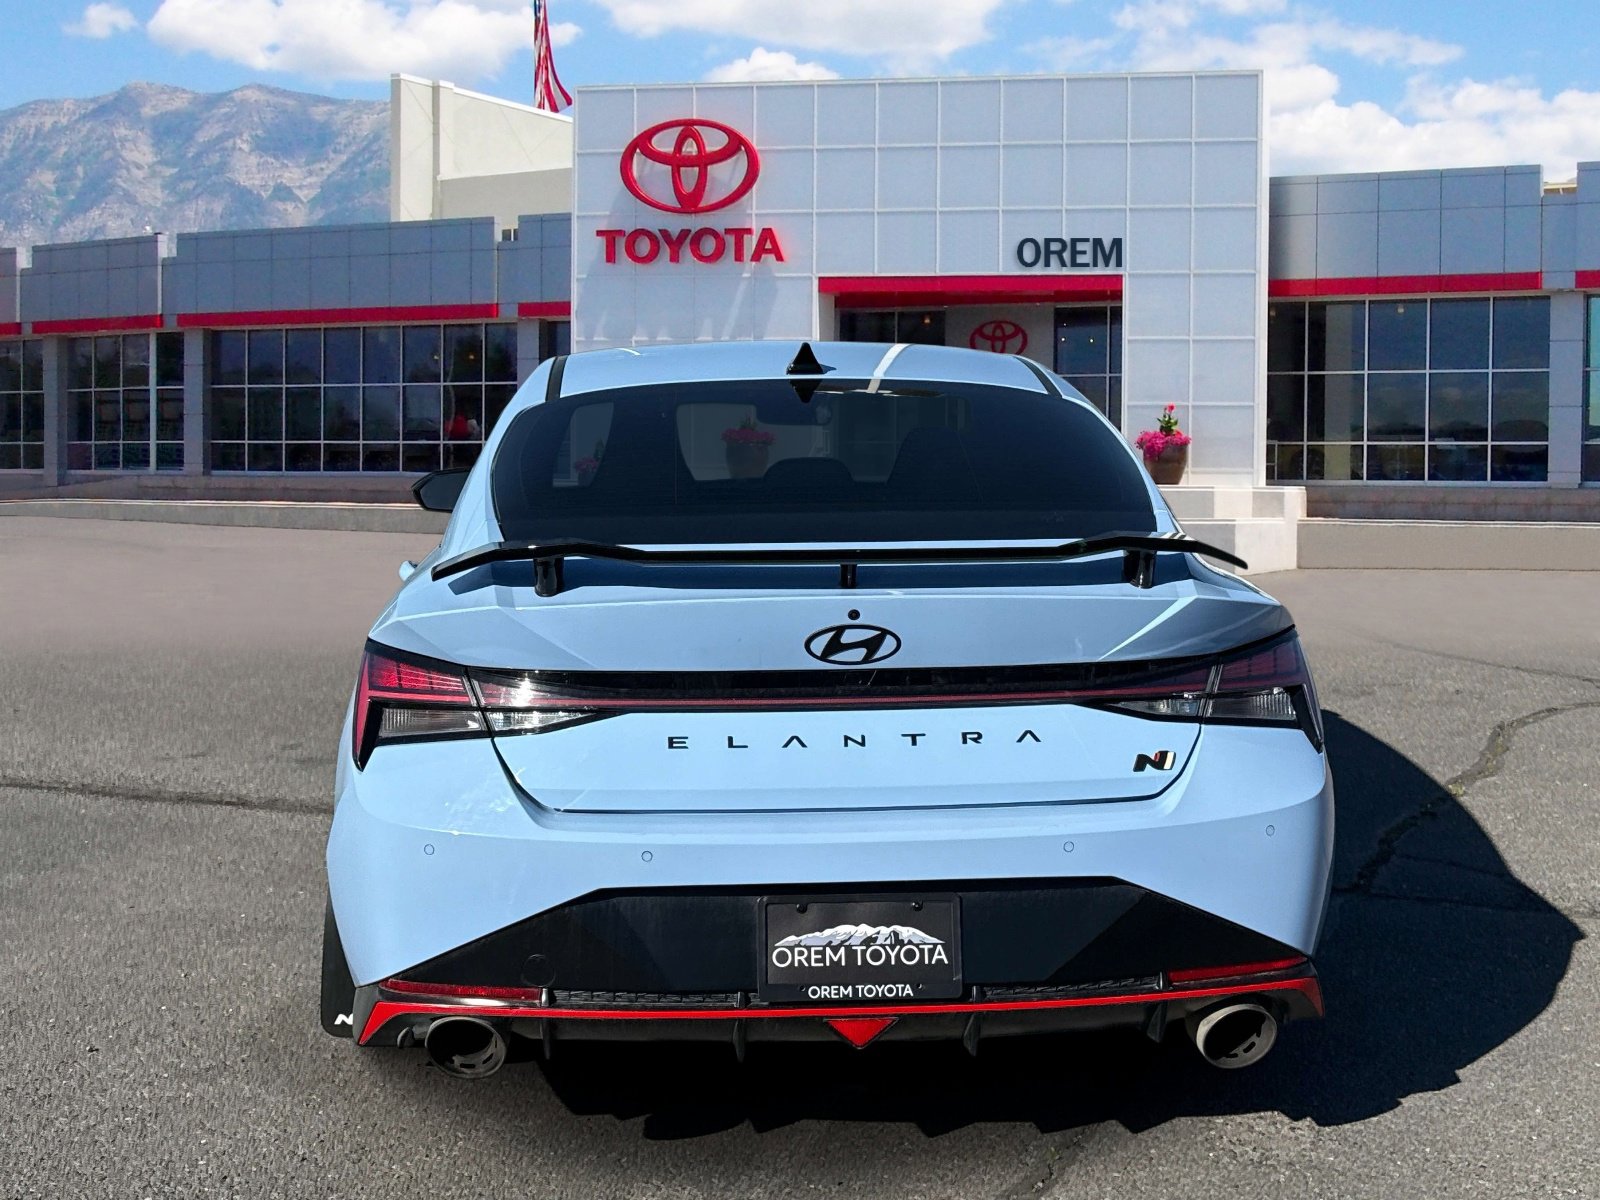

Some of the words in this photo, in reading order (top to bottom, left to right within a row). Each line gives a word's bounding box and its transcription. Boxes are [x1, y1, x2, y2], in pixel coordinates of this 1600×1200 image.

[596, 228, 785, 264] TOYOTA
[1017, 237, 1123, 268] OREM
[667, 729, 1042, 750] ELANTRA
[772, 946, 846, 968] OREM
[852, 945, 949, 966] TOYOTA
[808, 985, 853, 999] OREM
[855, 984, 914, 998] TOYOTA
